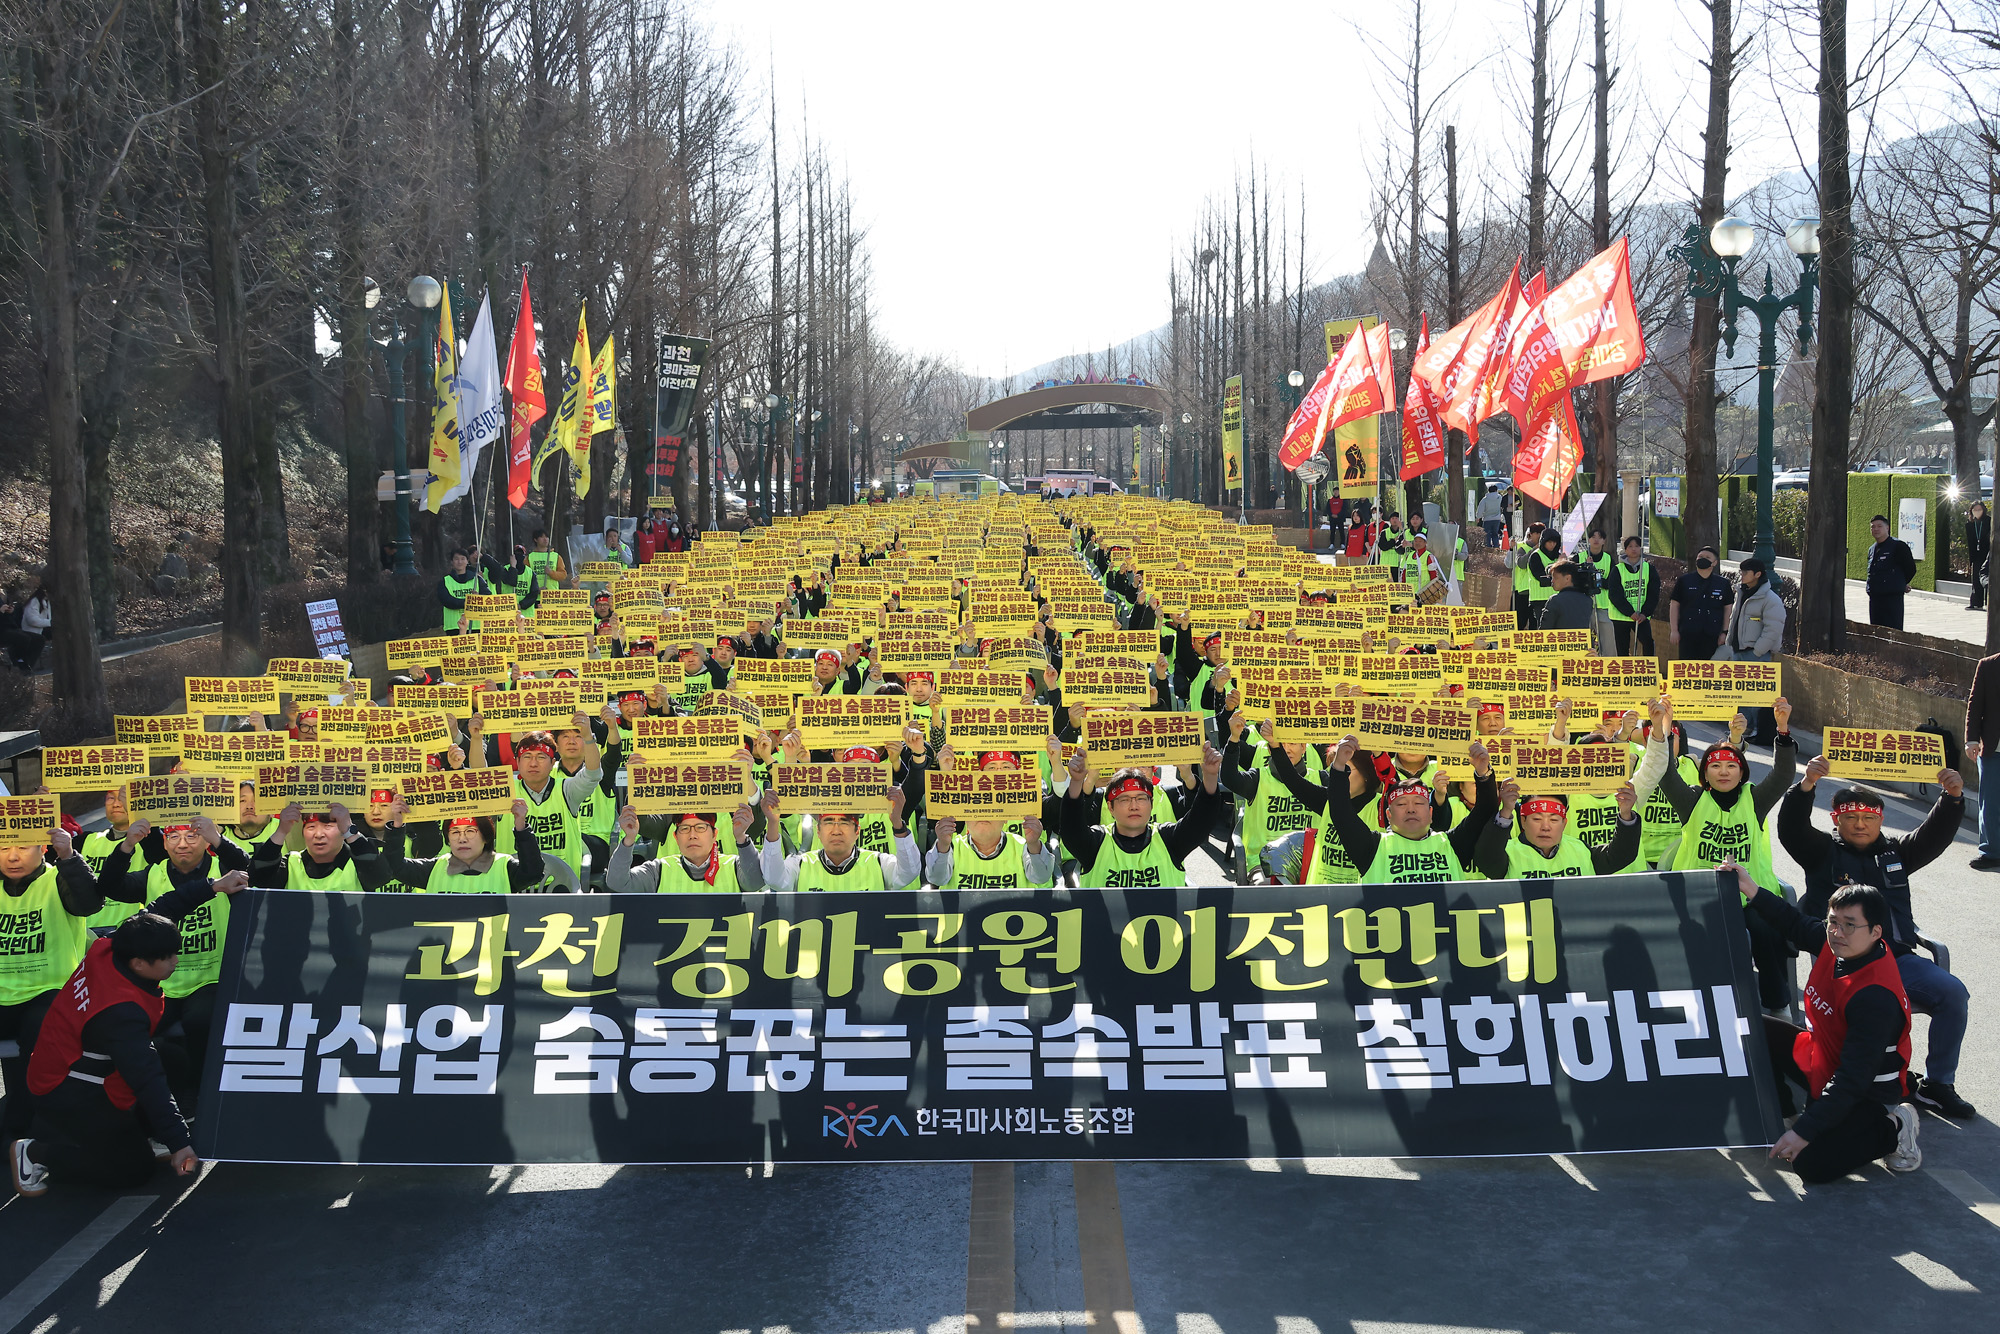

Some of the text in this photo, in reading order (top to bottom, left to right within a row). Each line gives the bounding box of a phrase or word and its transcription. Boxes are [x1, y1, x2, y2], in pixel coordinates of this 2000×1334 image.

[662, 345, 691, 362] 과천
[662, 362, 700, 376] 경마공원
[1362, 656, 1439, 669] 말산업 숨통끊는
[1562, 659, 1655, 674] 말산업 숨통끊는
[940, 671, 1021, 685] 말산업 숨통끊는
[1065, 669, 1145, 683] 말산업 숨통끊는
[1361, 668, 1440, 679] 과천경마공원 이전반대
[1468, 667, 1547, 683] 말산업 숨통끊는
[1673, 663, 1775, 679] 말산업 숨통끊는
[189, 679, 273, 692] 말산업 숨통끊는
[1065, 682, 1146, 693] 과천경마공원 이전반대
[1467, 681, 1547, 691] 과천경마공원 이전반대
[1562, 675, 1656, 686] 과천경마공원 이전반대
[1672, 679, 1775, 691] 과천경마공원 이전반대
[190, 691, 274, 702] 과천경마공원 이전반대
[482, 690, 574, 708] 말산업 숨통끊는
[938, 685, 1023, 697] 과천경마공원 이전반대
[482, 705, 577, 721] 과천경마공원 이전반대
[802, 698, 900, 714] 말산업 숨통끊는
[801, 714, 900, 726] 과천경마공원 이전반대
[951, 708, 1048, 723] 말산업 숨통끊는
[1362, 705, 1471, 727] 말산업 숨통끊는
[637, 718, 737, 735] 말산업 숨통끊는
[950, 724, 1050, 736] 과천경마공원 이전반대
[1087, 715, 1198, 737] 말산업 숨통끊는
[1359, 721, 1470, 741] 과천경마공원 이전반대
[183, 734, 283, 750] 말산업 숨통끊는
[637, 734, 738, 748] 과천경마공원 이전반대
[1087, 734, 1200, 751] 과천경마공원 이전반대
[1829, 730, 1939, 752] 말산업 숨통끊는
[46, 747, 143, 765] 말산업 숨통끊는
[183, 749, 284, 762] 과천경마공원 이전반대
[1517, 747, 1624, 764] 말산업 숨통끊는
[1826, 749, 1942, 766] 과천경마공원 이전반대
[45, 763, 143, 777] 과천경마공원 이전반대
[259, 765, 366, 784] 말산업 숨통끊는
[633, 765, 741, 783] 말산업 숨통끊는
[778, 766, 886, 783] 말산업 숨통끊는
[1516, 764, 1624, 777] 과천경마공원 이전반대
[130, 777, 233, 797] 말산업 숨통끊는
[401, 770, 507, 793] 말산업 숨통끊는
[633, 782, 742, 797] 과천경마공원 이전반대
[930, 773, 1035, 790] 말산업 숨통끊는
[259, 783, 365, 797] 과천경마공원 이전반대
[404, 786, 510, 808] 과천경마공원 이전반대
[777, 784, 889, 799] 과천경마공원 이전반대
[930, 789, 1036, 804] 과천경마공원 이전반대
[130, 794, 234, 811] 과천경마공원 이전반대
[10, 816, 55, 830] 이전반대
[1700, 820, 1749, 844] 경마공원
[1389, 852, 1449, 874] 경마공원
[1106, 866, 1161, 888] 경마공원
[0, 909, 43, 935] 마공원
[0, 932, 46, 955] 전반대
[406, 898, 1558, 998] 과천 경마공원 이전반대
[73, 956, 90, 1012] TAFF
[1806, 985, 1834, 1016] STAFF
[219, 984, 1750, 1096] 말산업 숨통끊는 졸속발표 철회하라
[822, 1107, 910, 1145] KRA
[917, 1106, 1135, 1136] 한국마사회노동조합
